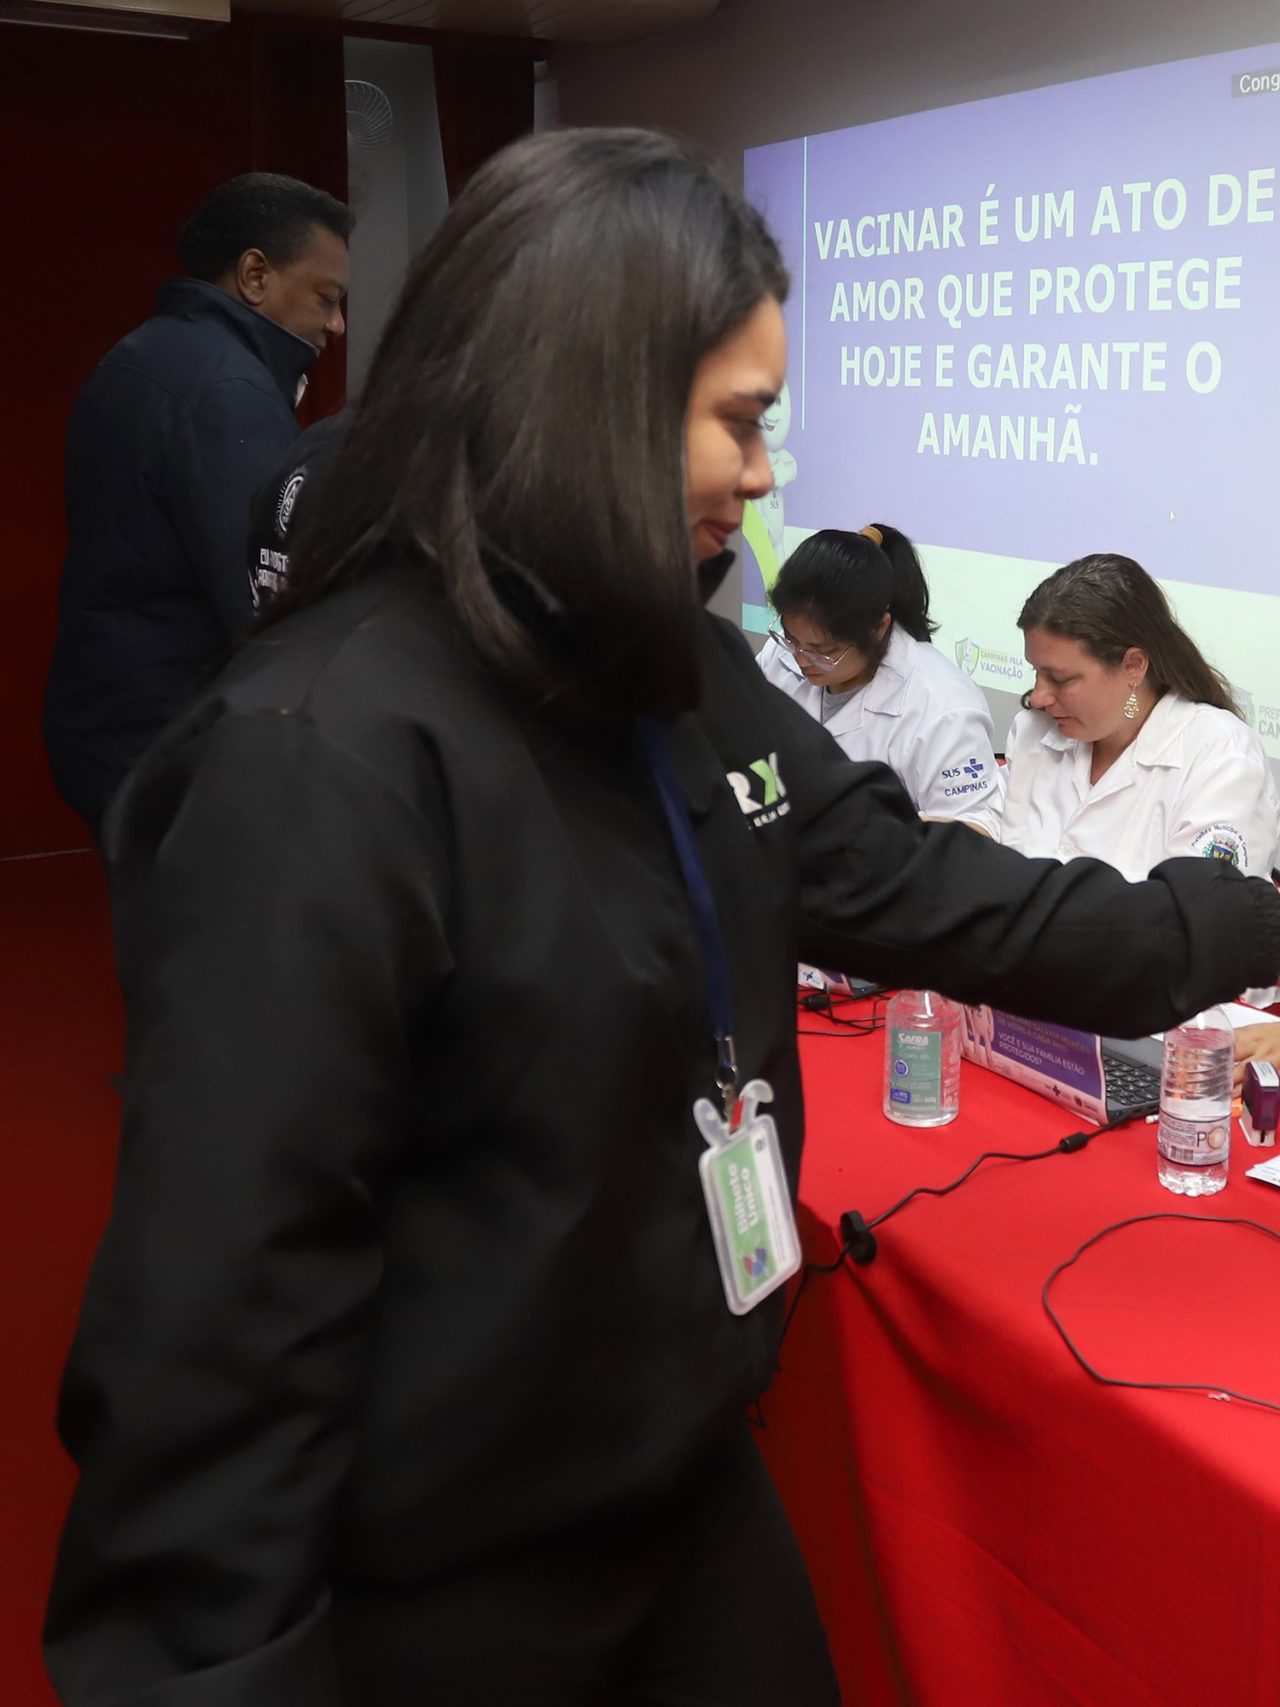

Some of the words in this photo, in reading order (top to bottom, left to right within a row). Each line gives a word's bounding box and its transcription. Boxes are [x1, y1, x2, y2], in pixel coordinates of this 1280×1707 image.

[814, 204, 966, 260] VACINAR
[979, 183, 1000, 246] É
[1014, 190, 1075, 243] UM
[1090, 178, 1187, 236] ATO
[1208, 168, 1276, 226] DE
[829, 277, 926, 322] AMOR
[938, 271, 1014, 329] QUE
[1029, 256, 1243, 315] PROTEGE
[840, 345, 922, 388] HOJE
[935, 344, 954, 388] E
[967, 342, 1167, 392] GARANTE
[1185, 341, 1223, 394] O
[916, 403, 1099, 466] AMANHÃ.
[980, 660, 1024, 680] VACINAÇÃO
[941, 768, 961, 779] SUS
[944, 781, 988, 797] CAMPINAS
[1022, 1041, 1035, 1054] SUA
